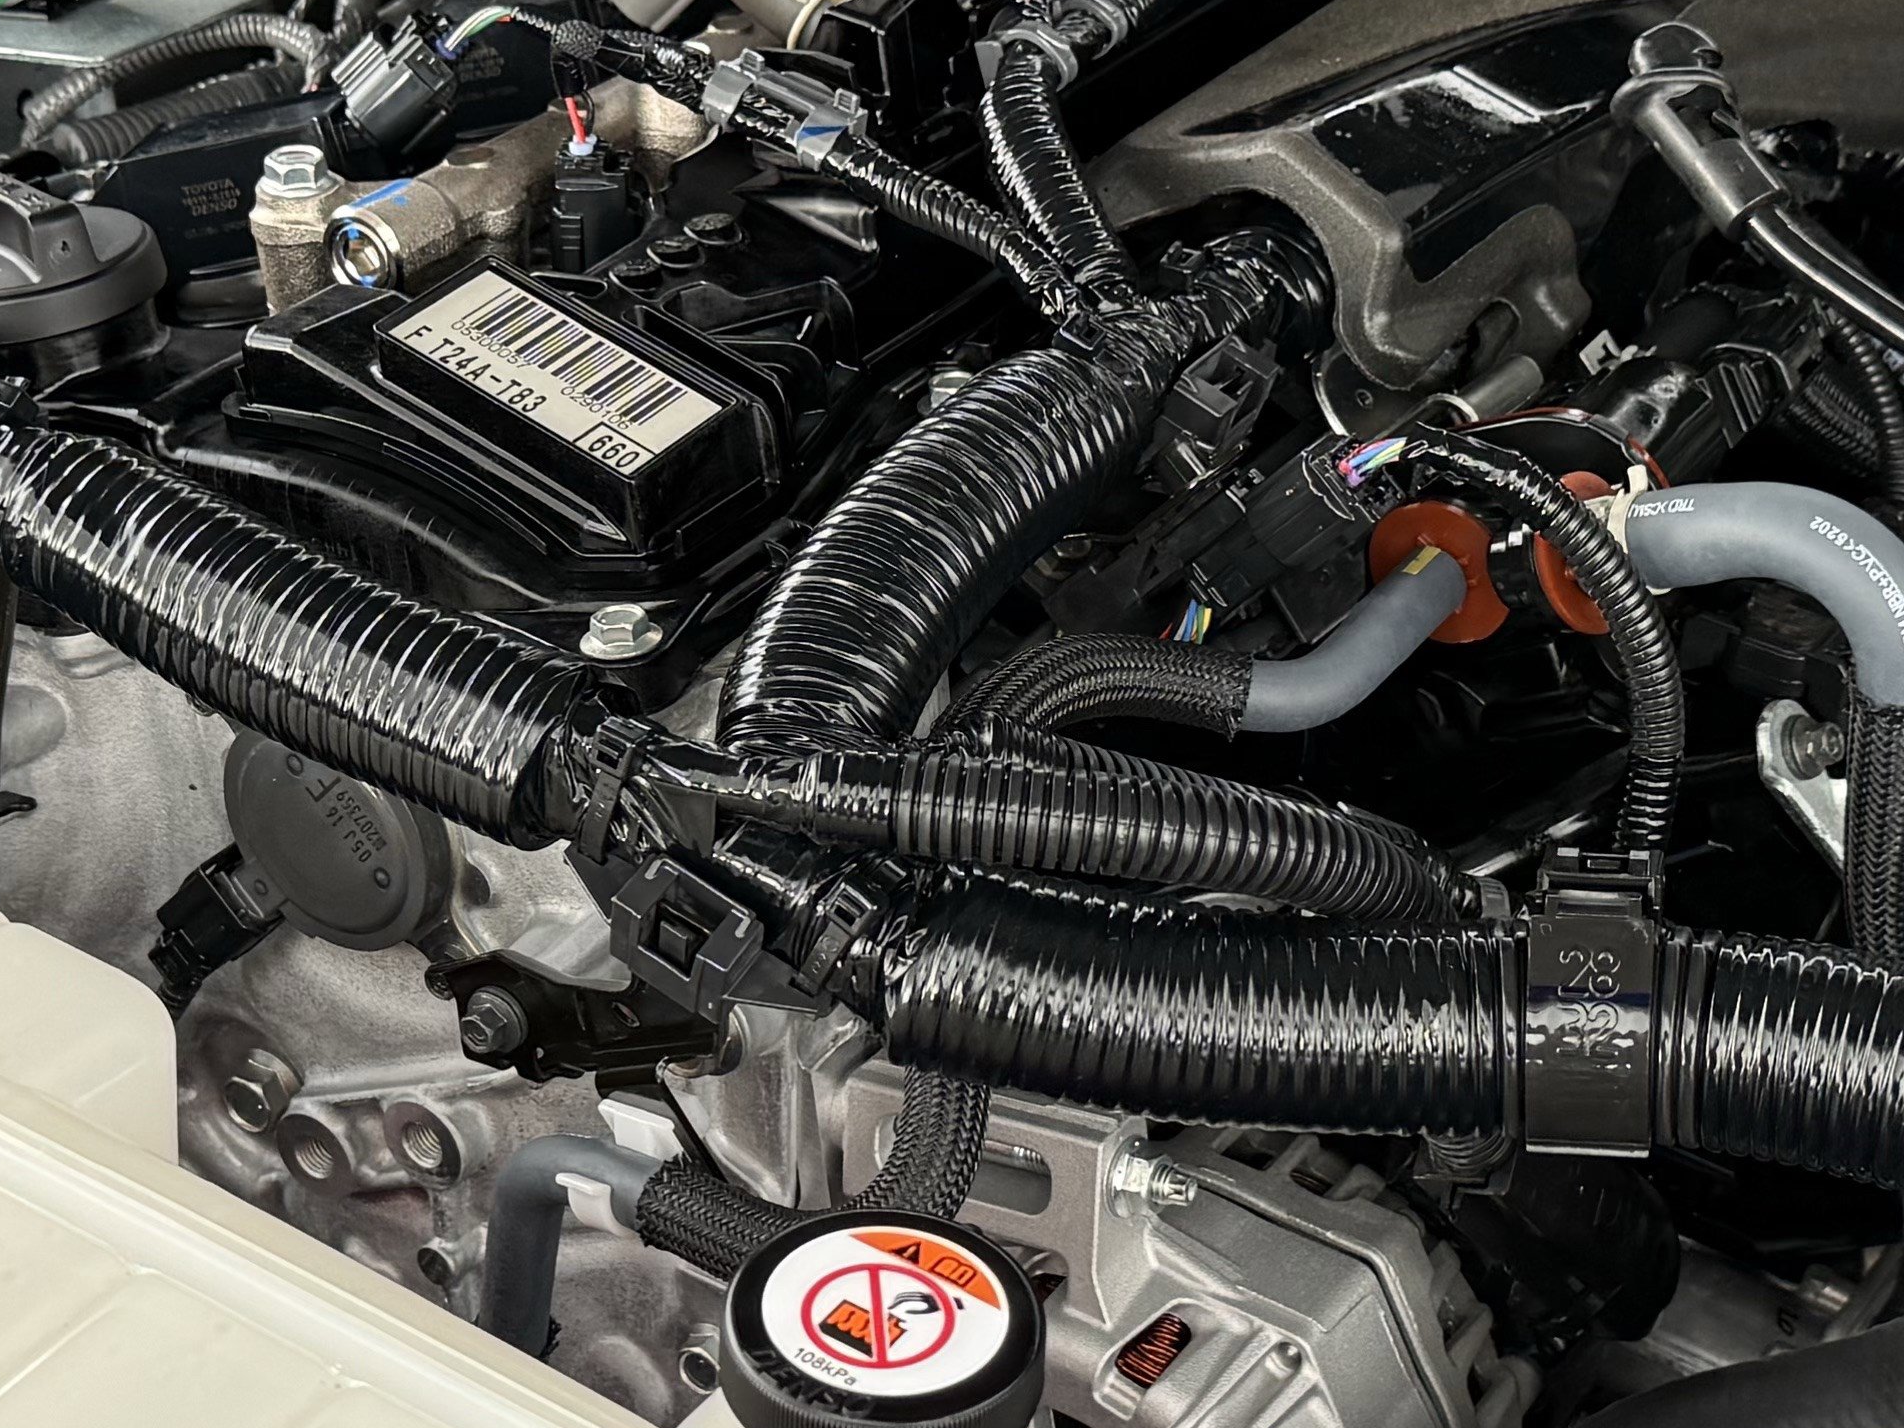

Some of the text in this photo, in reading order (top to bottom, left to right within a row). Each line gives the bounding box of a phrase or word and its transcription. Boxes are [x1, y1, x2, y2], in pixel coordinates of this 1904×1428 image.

[450, 318, 535, 370] 05300057
[404, 324, 547, 414] F T24A-T83
[560, 384, 633, 430] 0290106
[587, 432, 642, 471] 660
[304, 775, 342, 803] F
[794, 1348, 857, 1386] 108kPa
